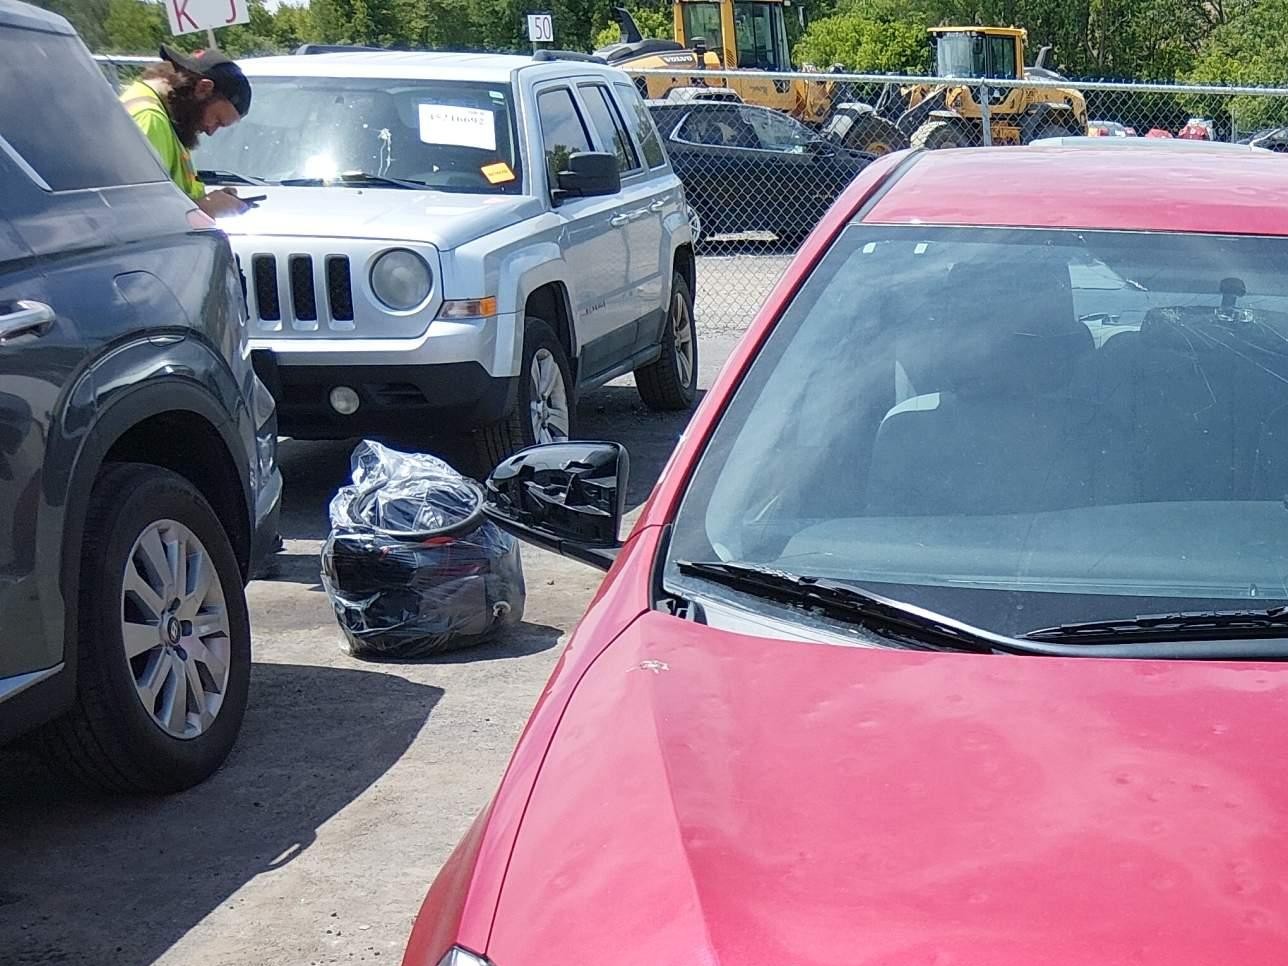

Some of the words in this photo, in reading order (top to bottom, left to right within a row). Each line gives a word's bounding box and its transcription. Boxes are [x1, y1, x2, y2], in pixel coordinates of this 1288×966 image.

[173, 0, 199, 32] K
[534, 16, 551, 40] 50
[664, 55, 693, 63] VOLVO
